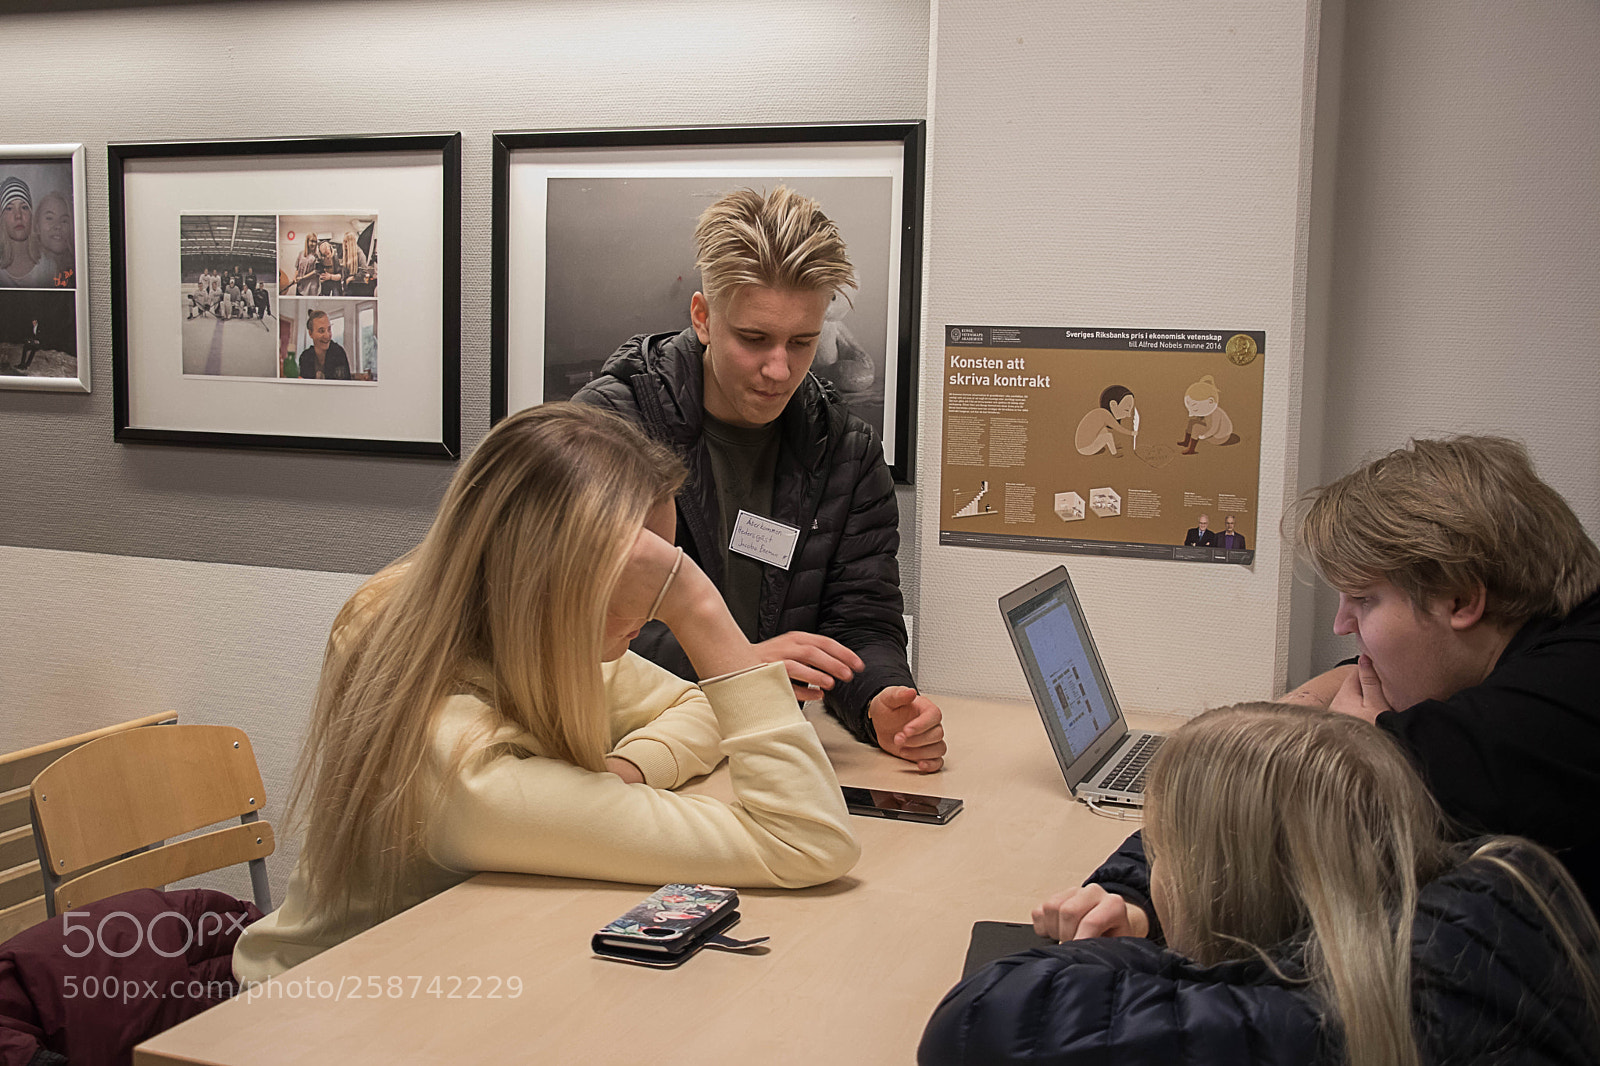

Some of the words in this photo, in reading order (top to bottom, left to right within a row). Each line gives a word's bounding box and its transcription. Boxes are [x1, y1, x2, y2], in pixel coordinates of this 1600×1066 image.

[1065, 330, 1095, 339] Sveriges
[1095, 331, 1130, 339] Riksbanks
[1130, 332, 1144, 340] pris
[1148, 332, 1186, 340] ekonomisk
[1186, 333, 1222, 342] vetenskap
[1159, 341, 1183, 349] Nobels
[1205, 342, 1222, 350] 2016
[950, 355, 1004, 370] Konsten
[1006, 357, 1025, 370] att
[949, 372, 990, 386] skriva
[993, 373, 1051, 388] kontrakt
